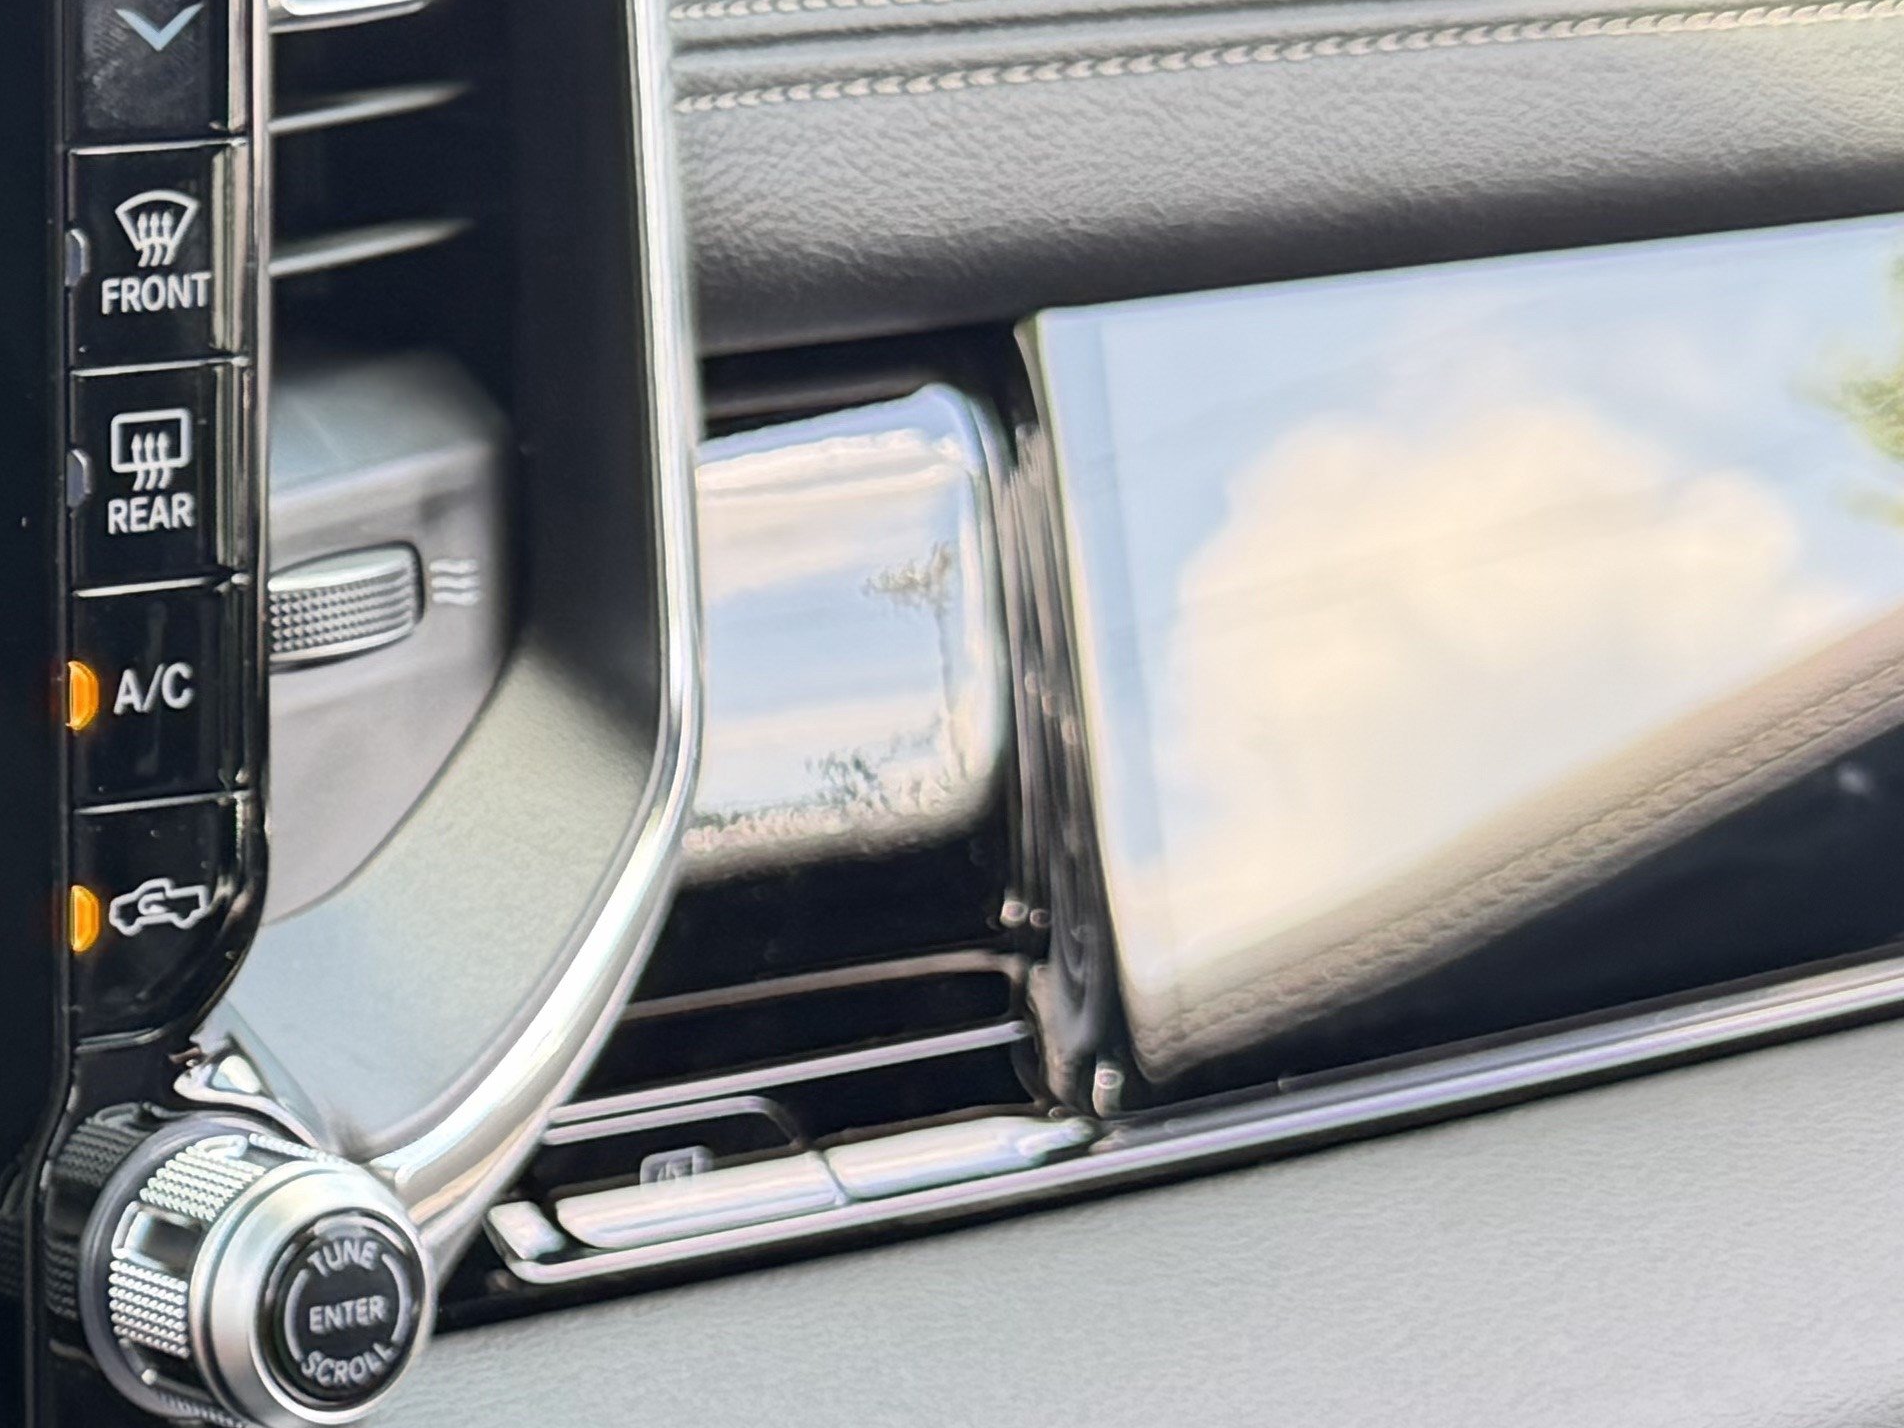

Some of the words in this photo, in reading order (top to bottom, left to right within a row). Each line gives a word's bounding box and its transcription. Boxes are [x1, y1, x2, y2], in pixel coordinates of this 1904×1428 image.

[102, 271, 210, 315] FRONT
[108, 495, 194, 536] REAR
[114, 661, 194, 713] A/C
[308, 1238, 380, 1275] TUNE
[309, 1294, 385, 1331] ENTER
[300, 1343, 397, 1386] SCROLL
